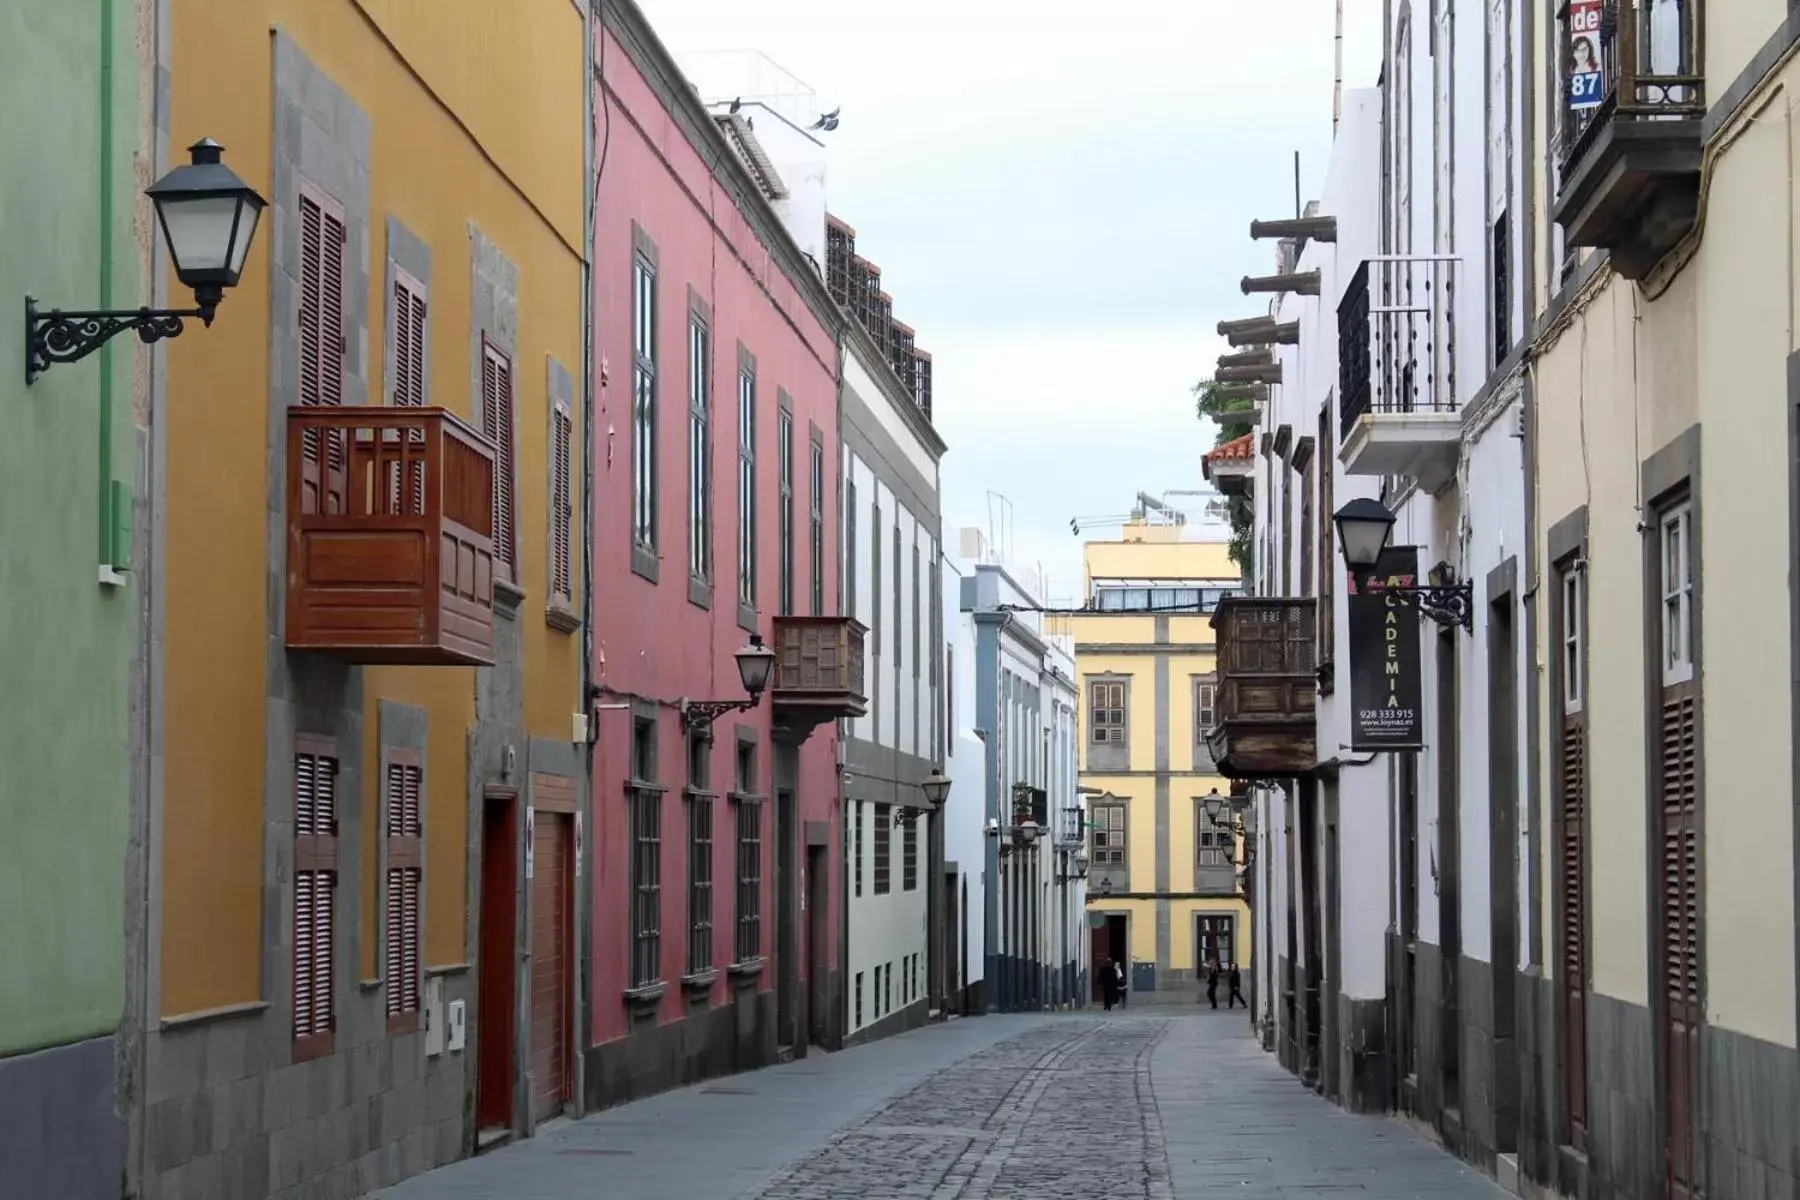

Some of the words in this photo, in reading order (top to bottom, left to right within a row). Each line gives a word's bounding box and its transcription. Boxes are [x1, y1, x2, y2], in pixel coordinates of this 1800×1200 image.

[1571, 73, 1599, 96] 87
[1385, 575, 1399, 707] ACADEMIA
[1360, 710, 1377, 719] 928
[1379, 710, 1395, 719] 333
[1397, 709, 1413, 718] 915
